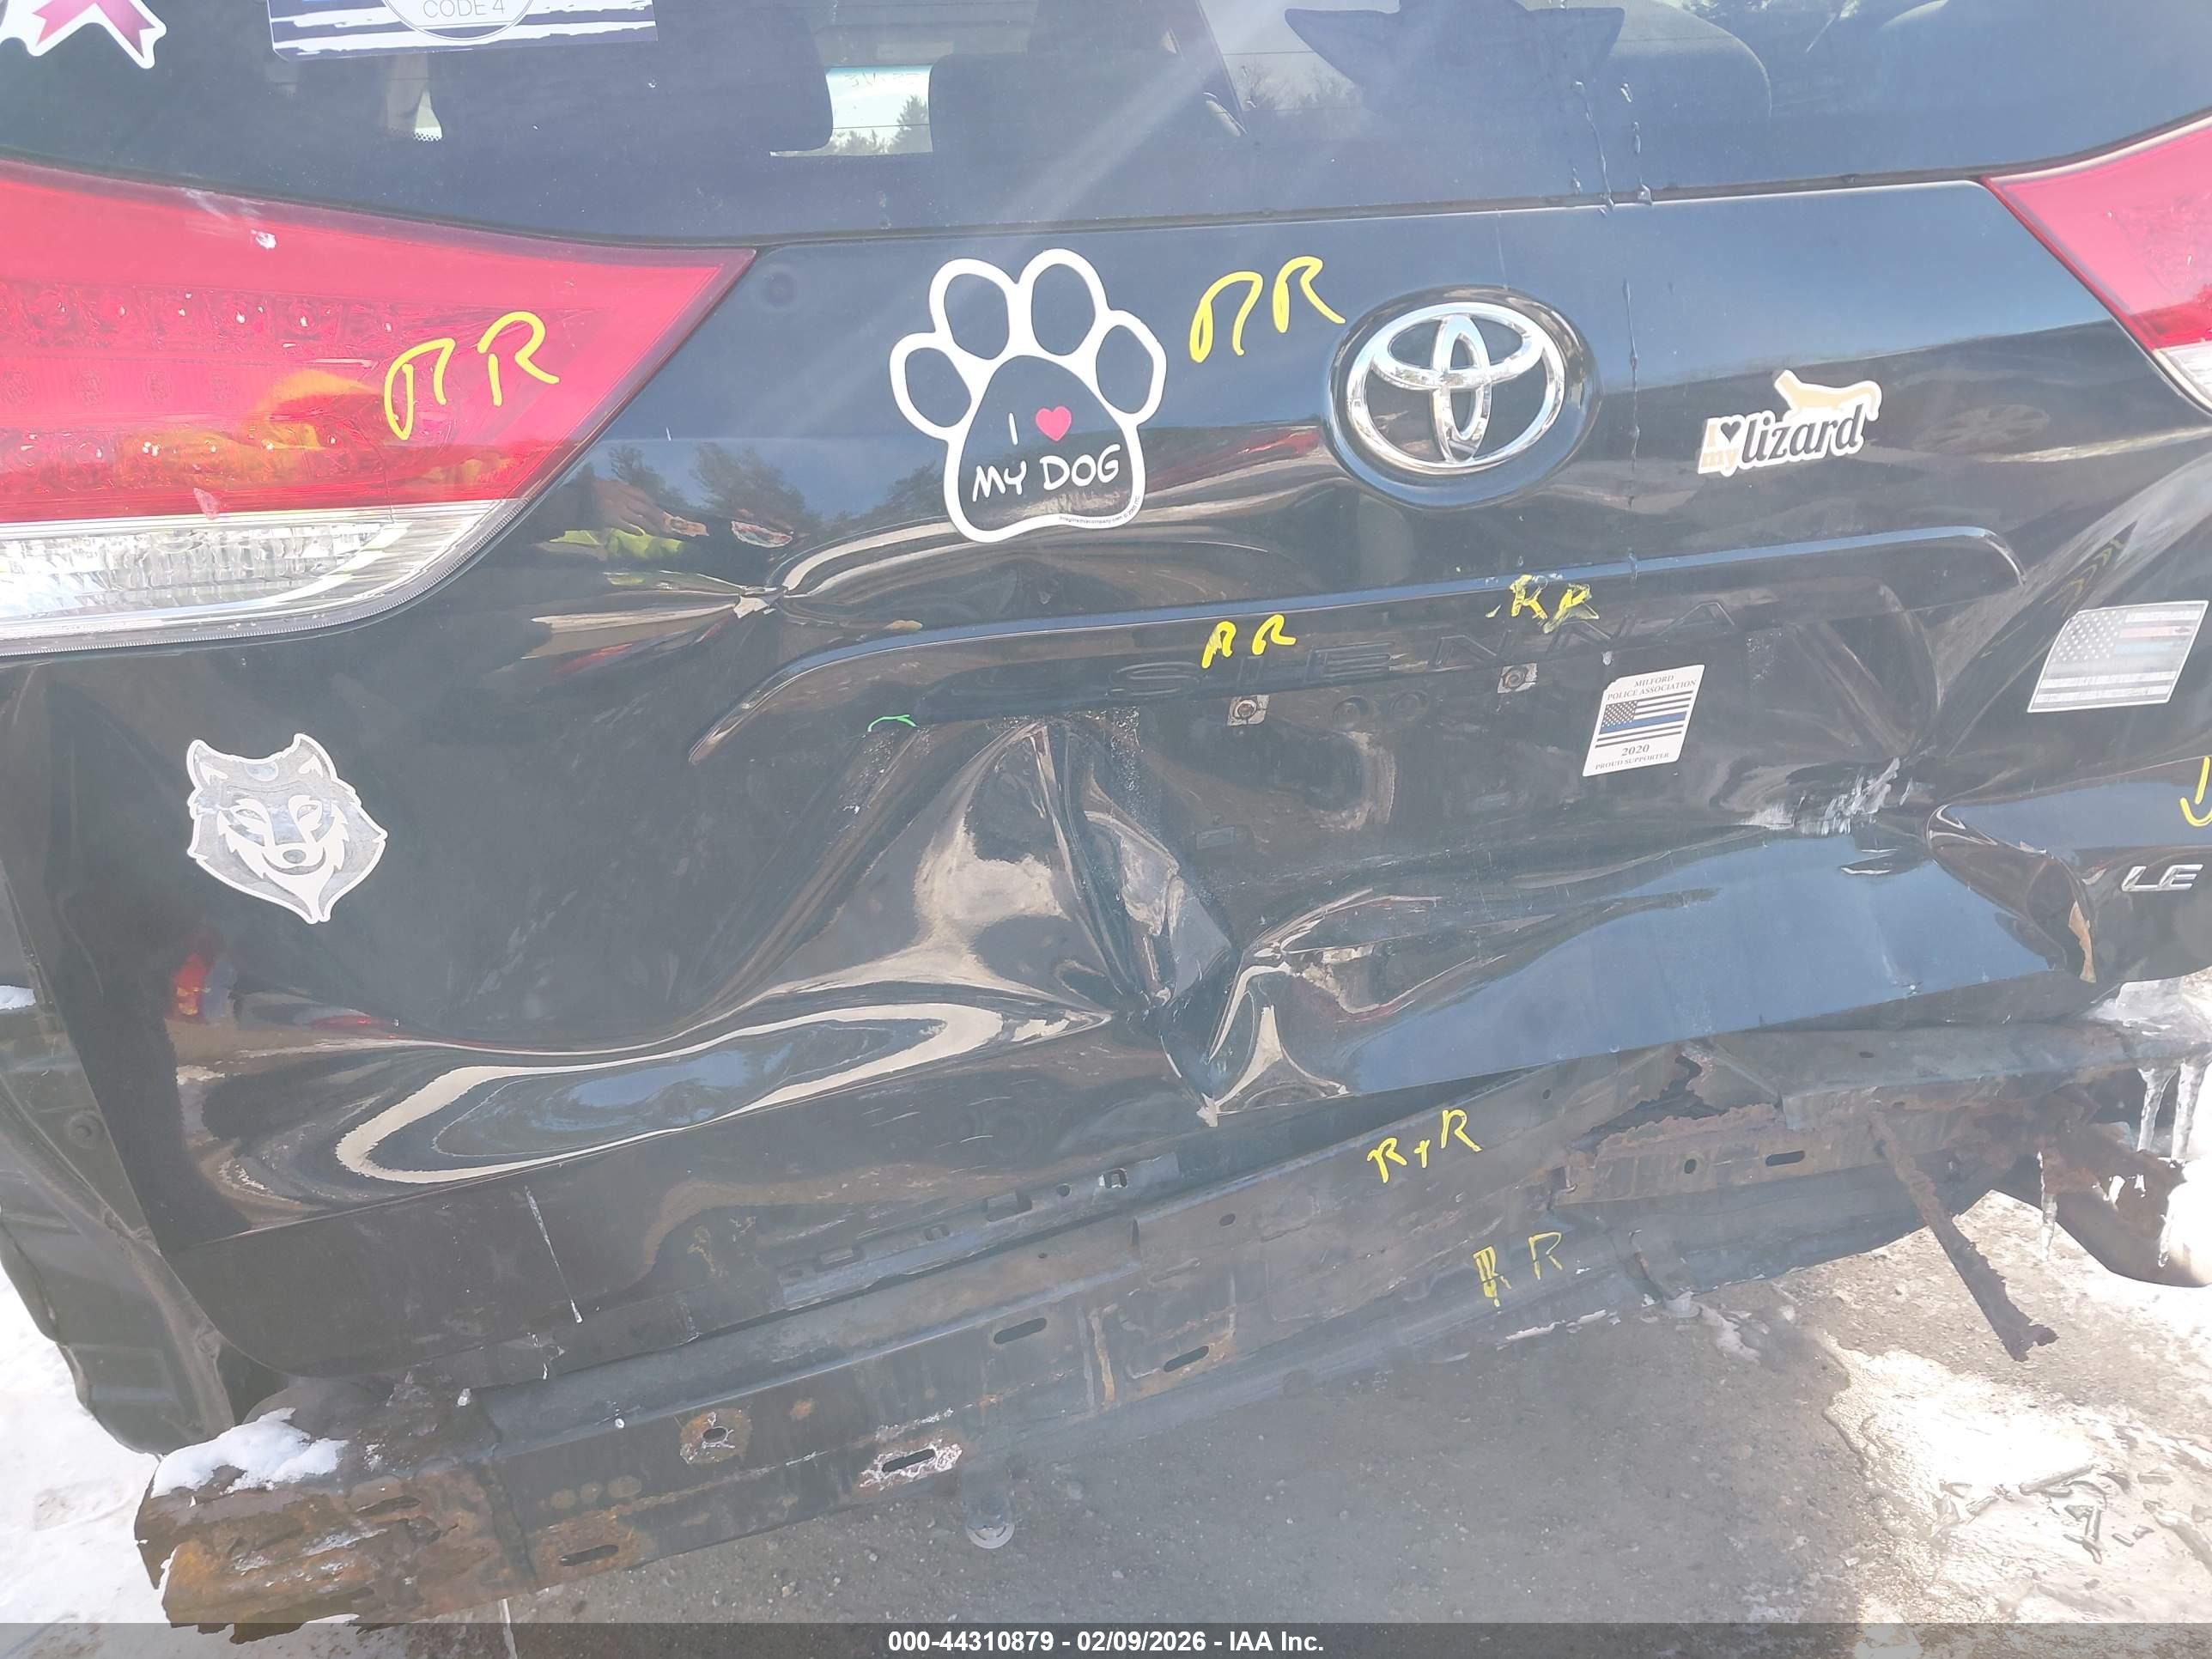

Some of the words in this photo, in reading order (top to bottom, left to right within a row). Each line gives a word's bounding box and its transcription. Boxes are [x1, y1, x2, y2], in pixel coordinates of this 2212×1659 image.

[423, 0, 485, 18] CODE
[492, 0, 507, 15] 4
[1008, 412, 1018, 446] I
[1741, 403, 1864, 465] lizard
[972, 460, 1027, 502] MY
[1039, 443, 1121, 491] DOG
[1607, 690, 1638, 702] POLICE
[1638, 678, 1698, 696] ASSOCIATION
[1633, 674, 1675, 688] MILFORD
[1595, 759, 1623, 771] PROUD
[1624, 752, 1670, 766] SUPPORTER
[1621, 744, 1650, 757] 2020
[2121, 864, 2204, 892] LE
